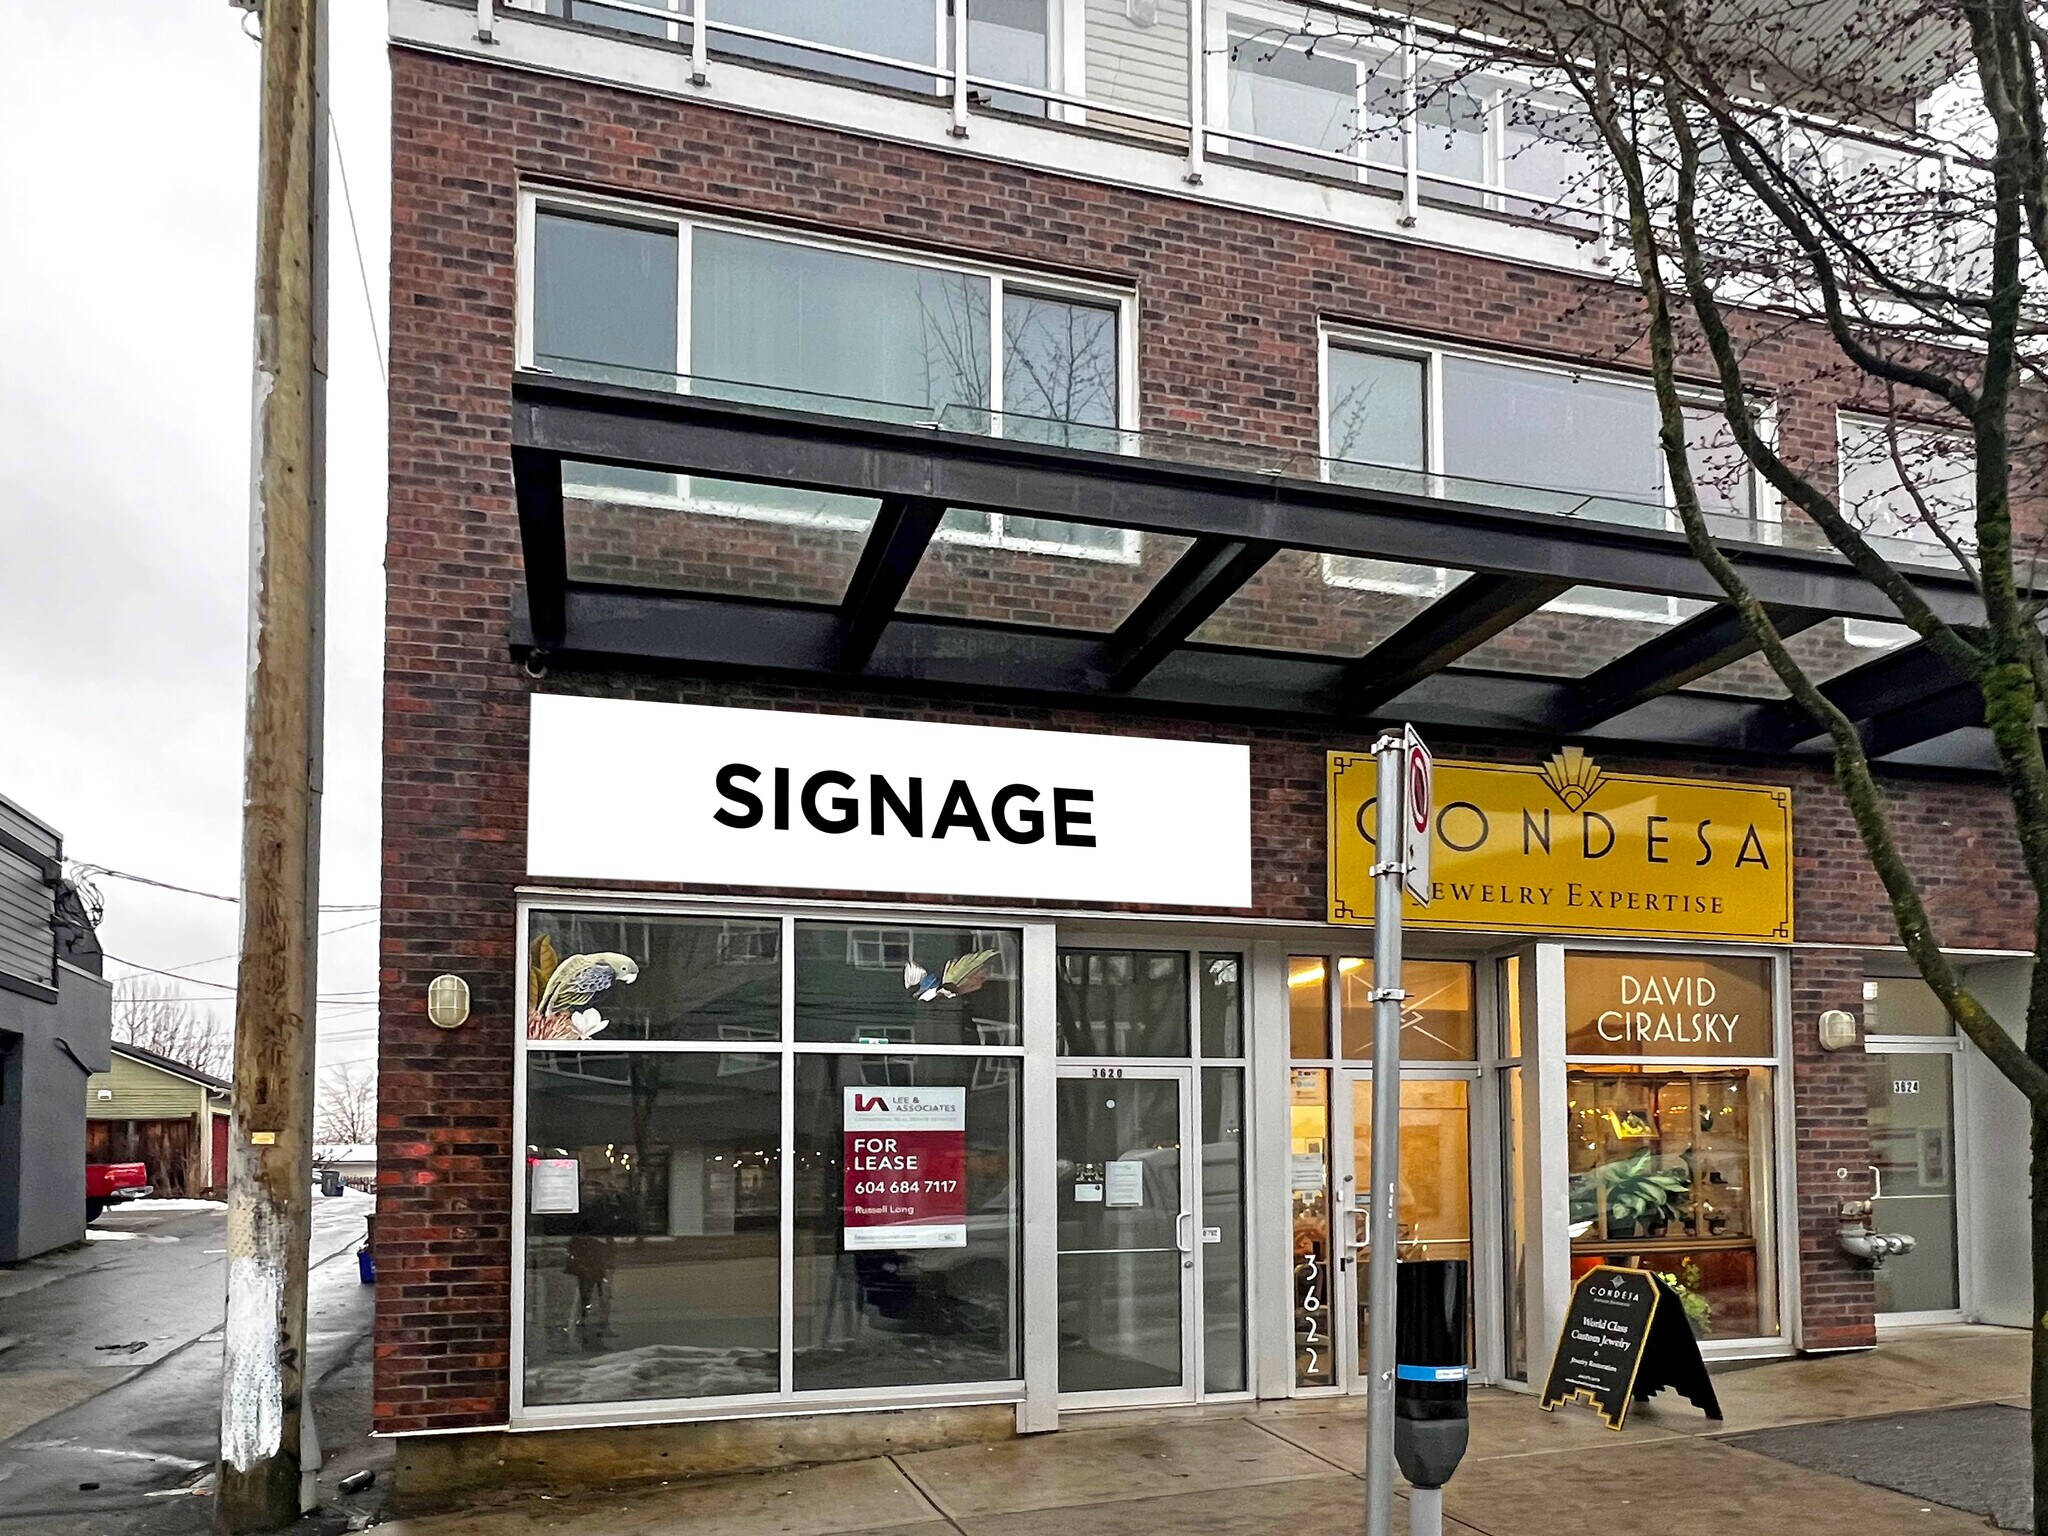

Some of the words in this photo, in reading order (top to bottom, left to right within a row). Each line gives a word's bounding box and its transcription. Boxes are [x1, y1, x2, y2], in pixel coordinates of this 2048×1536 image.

[712, 762, 1097, 848] SIGNAGE
[1411, 882, 1553, 907] EWELRY
[1566, 882, 1724, 914] EXPERTISE
[1620, 974, 1717, 1007] DAVID
[1596, 1010, 1740, 1043] CIRALSKY
[1092, 1068, 1123, 1079] 3620
[1894, 1081, 1919, 1093] 3624
[892, 1096, 910, 1104] LEE
[912, 1096, 920, 1104] &
[895, 1104, 957, 1112] ASSOCIATES
[854, 1138, 898, 1153] FOR
[854, 1155, 919, 1171] LEASE
[854, 1181, 886, 1195] 604
[889, 1180, 920, 1194] 684
[923, 1179, 958, 1193] 7117
[854, 1205, 888, 1215] Russell
[889, 1205, 915, 1216] Long
[1589, 1286, 1640, 1302] CONDESA
[1303, 1254, 1320, 1374] 3622
[1583, 1316, 1607, 1330] World
[1607, 1320, 1629, 1334] Class
[1570, 1329, 1601, 1343] Custom
[1598, 1334, 1632, 1351] Jewelry
